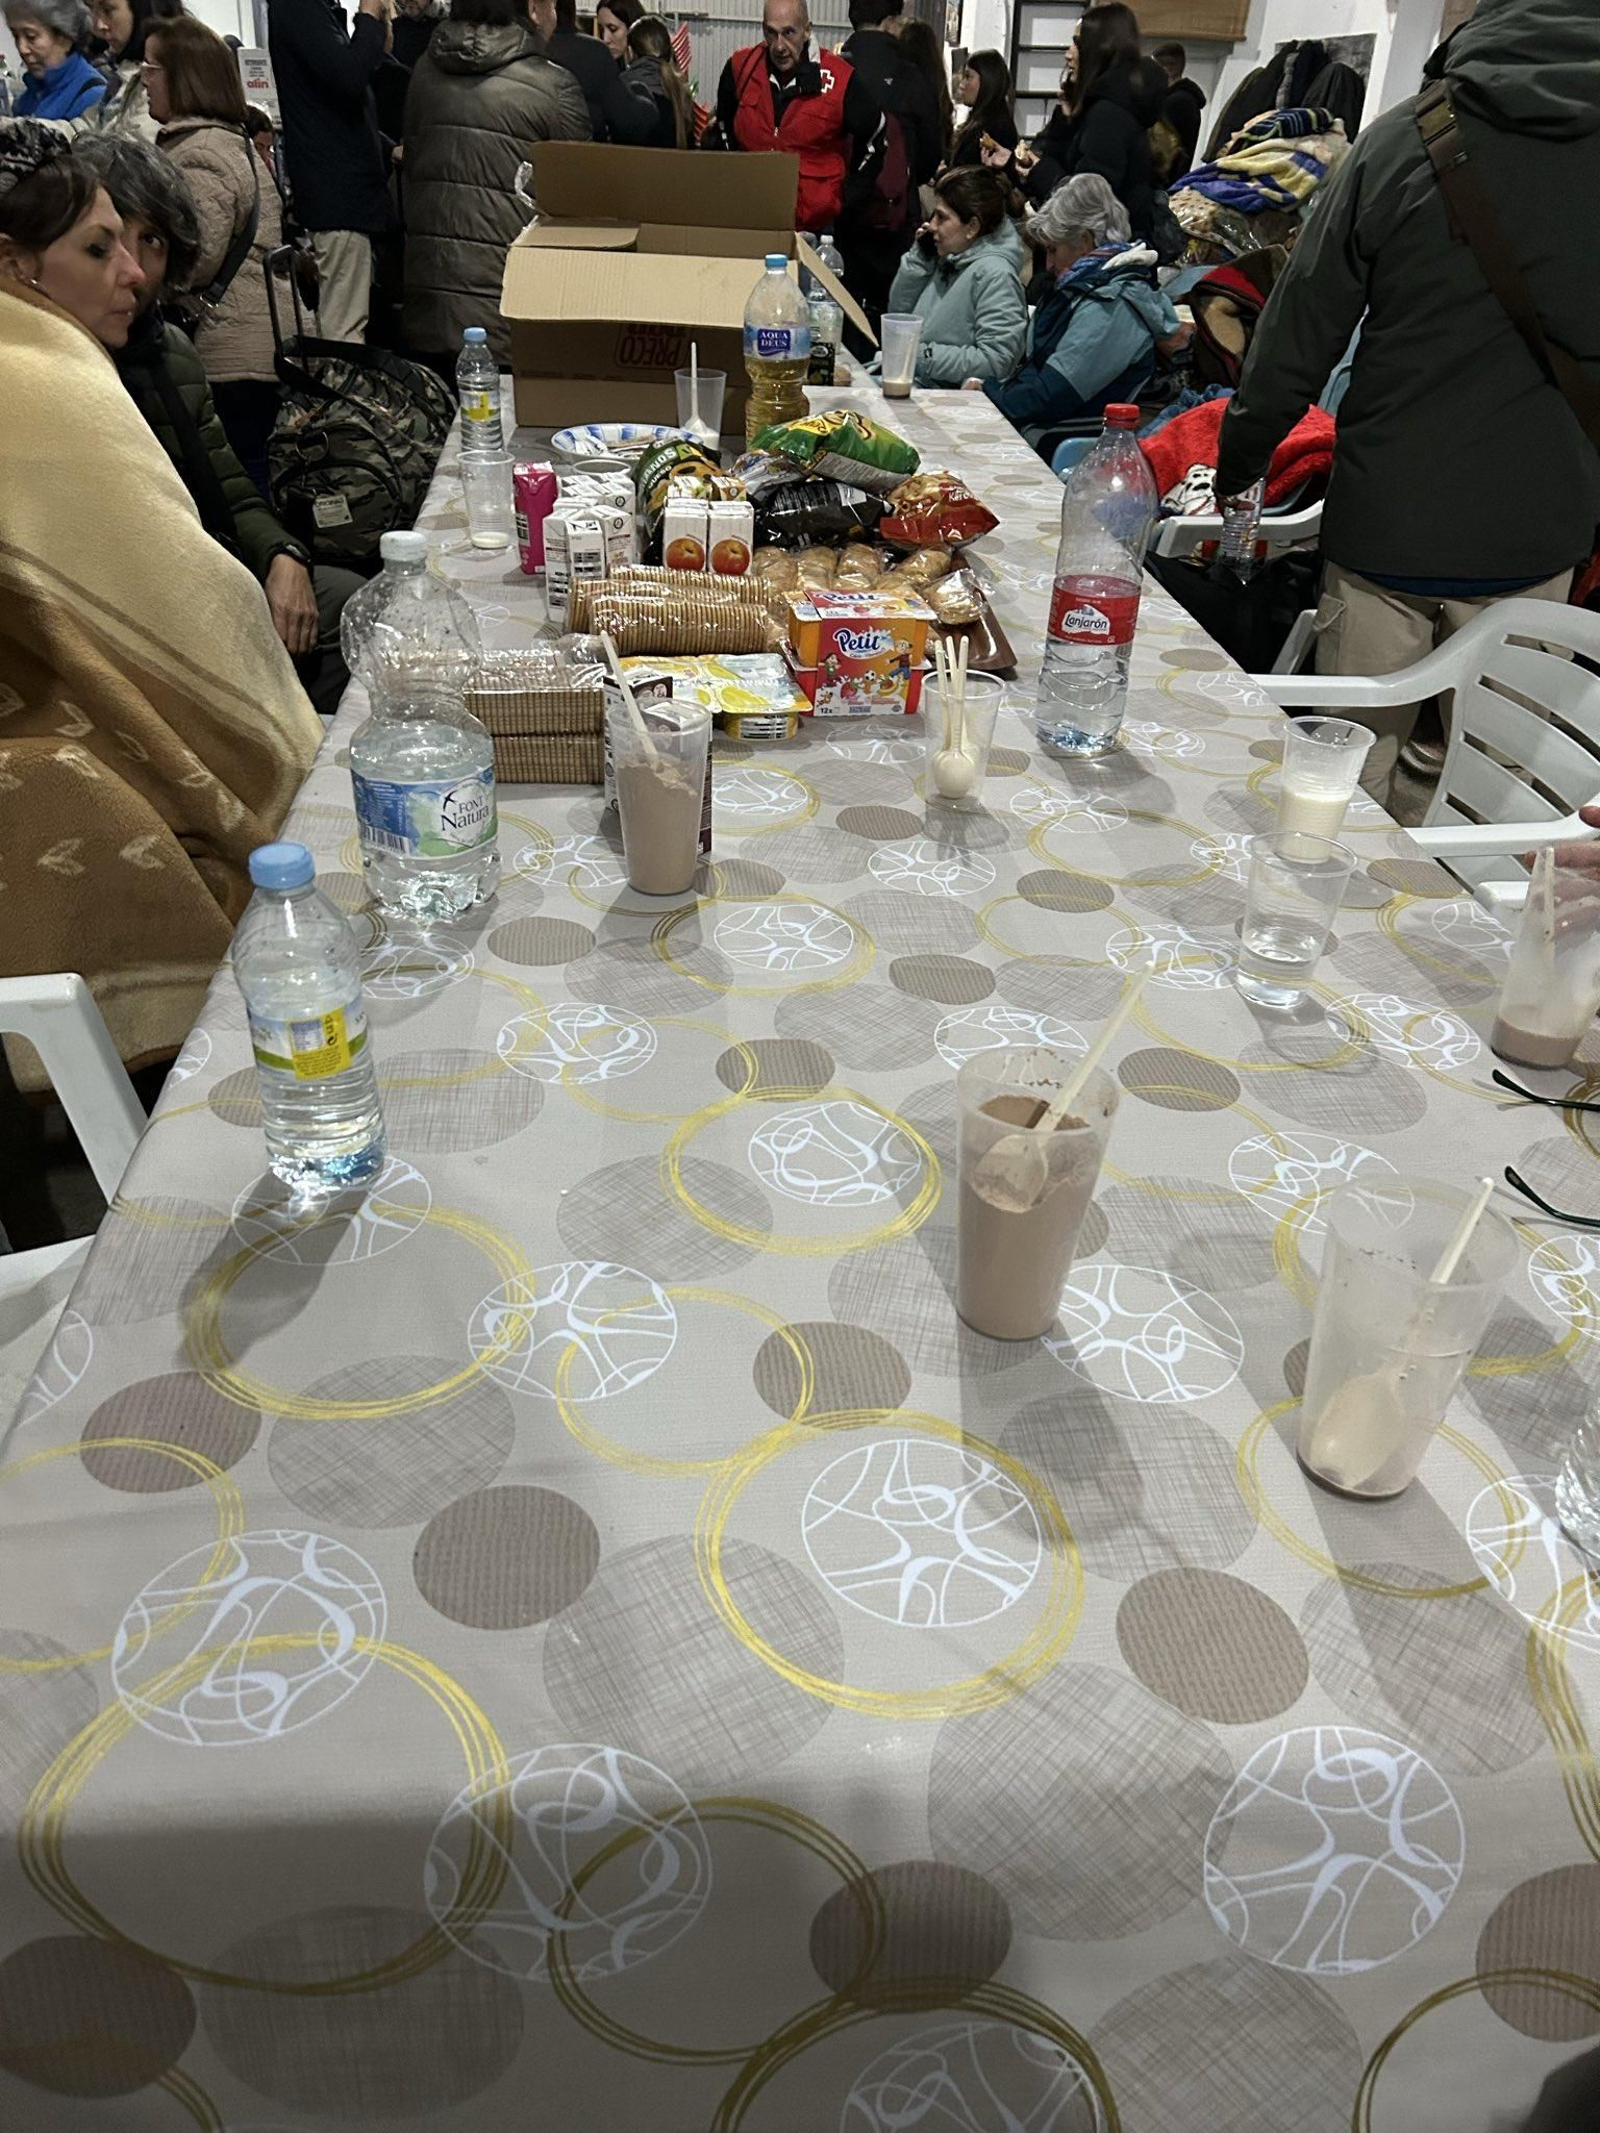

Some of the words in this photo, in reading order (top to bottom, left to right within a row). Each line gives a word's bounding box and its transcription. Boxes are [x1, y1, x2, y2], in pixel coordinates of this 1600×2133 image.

[760, 331, 788, 340] AQUA
[619, 336, 681, 366] PRECO
[1065, 614, 1107, 628] Lanjarón
[834, 629, 880, 652] Petit
[459, 796, 484, 814] FONT
[441, 805, 490, 832] Natura
